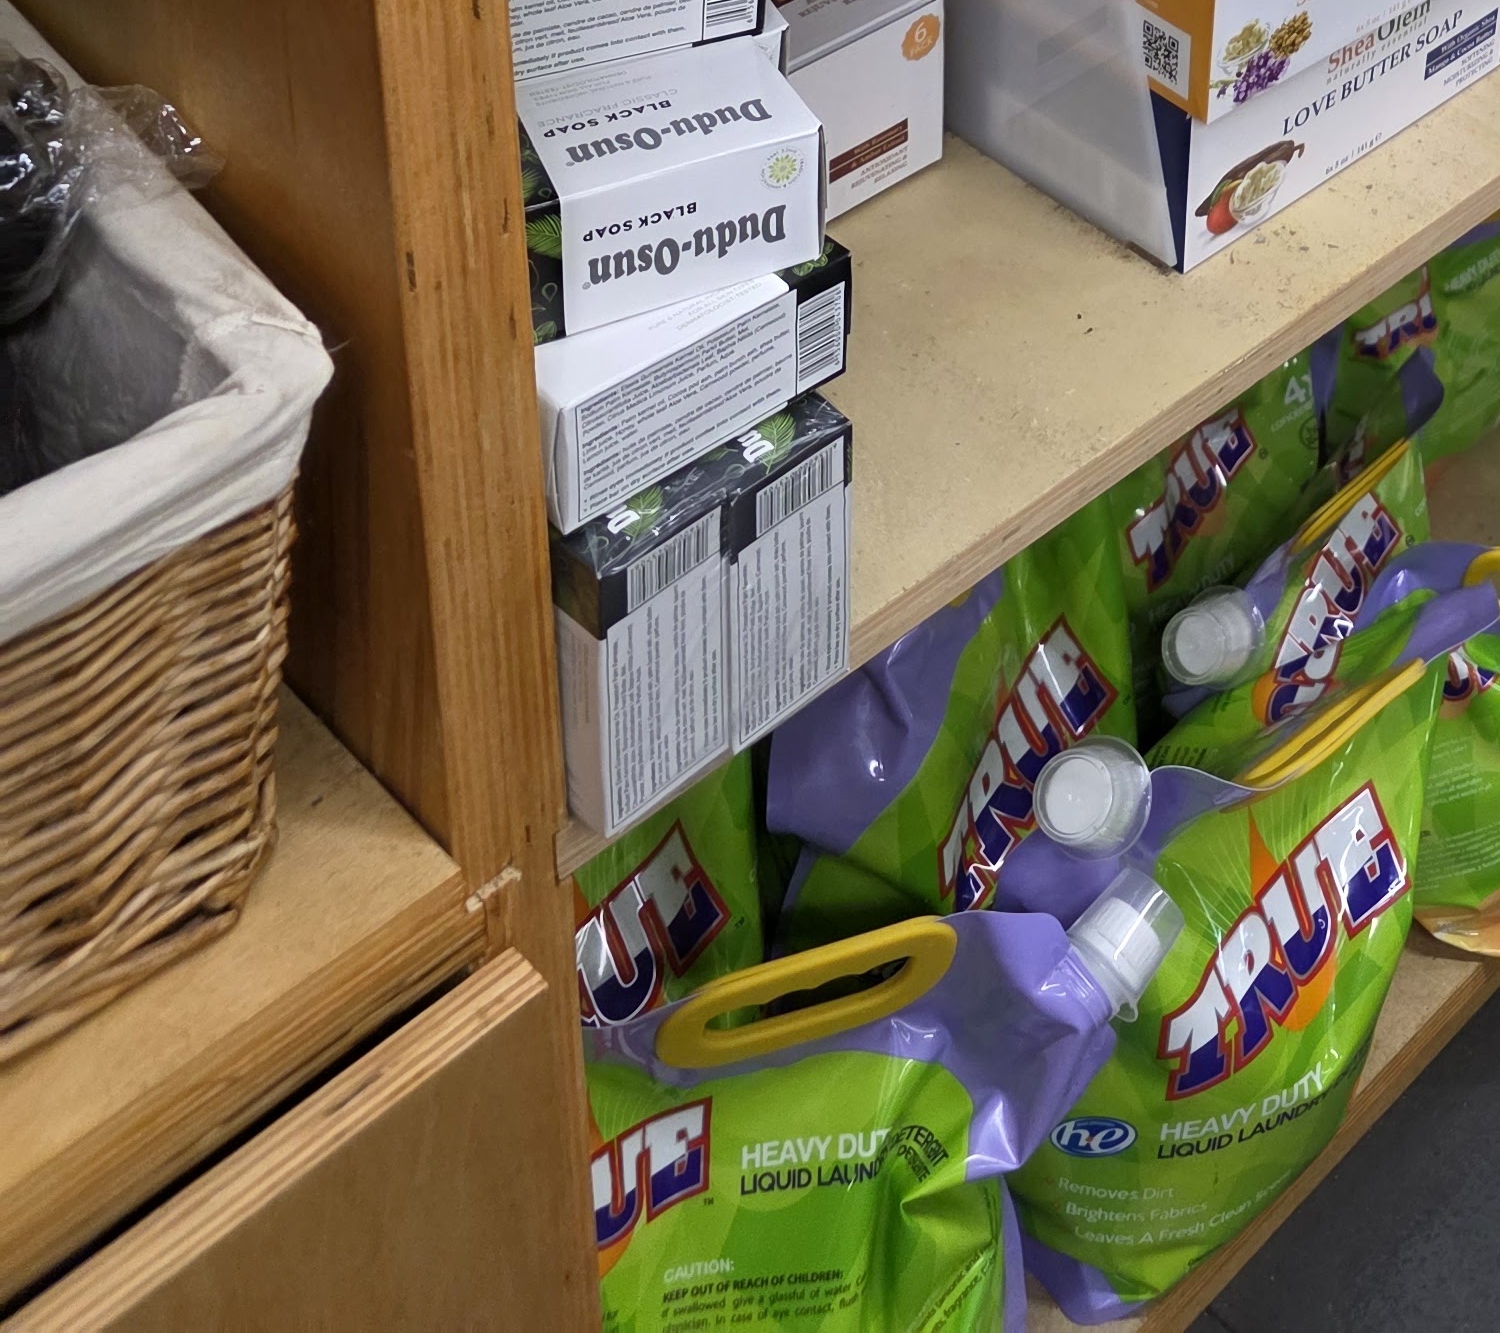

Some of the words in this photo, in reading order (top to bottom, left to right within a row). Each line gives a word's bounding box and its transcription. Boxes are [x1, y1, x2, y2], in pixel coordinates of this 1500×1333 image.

[913, 21, 927, 43] 6
[1281, 90, 1337, 136] LOVE
[1340, 43, 1412, 102] BUTTER
[1414, 9, 1464, 56] SOAP
[604, 99, 672, 123] BLACK
[543, 117, 600, 139] SOAP
[565, 98, 773, 164] Dudu-Osun
[637, 201, 698, 229] BLACK
[582, 219, 633, 243] SOAP
[587, 203, 787, 286] Dudu-Osun
[1157, 780, 1412, 1101] TRUE
[1159, 1102, 1259, 1141] HEAVY
[1261, 1061, 1325, 1118] DUTY
[740, 1133, 836, 1171] HEAVY
[1157, 1132, 1234, 1160] LIQUID
[740, 1165, 813, 1197] LIQUID
[1057, 1177, 1139, 1201] Removes
[1143, 1186, 1175, 1200] Dirt
[1149, 1200, 1209, 1222] Fabrics
[663, 1258, 735, 1285] CAUTION:
[662, 1287, 689, 1304] KEEP
[690, 1284, 715, 1299] OUT
[715, 1282, 730, 1296] OF
[732, 1276, 768, 1292] REACH
[768, 1274, 785, 1288] OF
[787, 1269, 844, 1286] CHILDREN:
